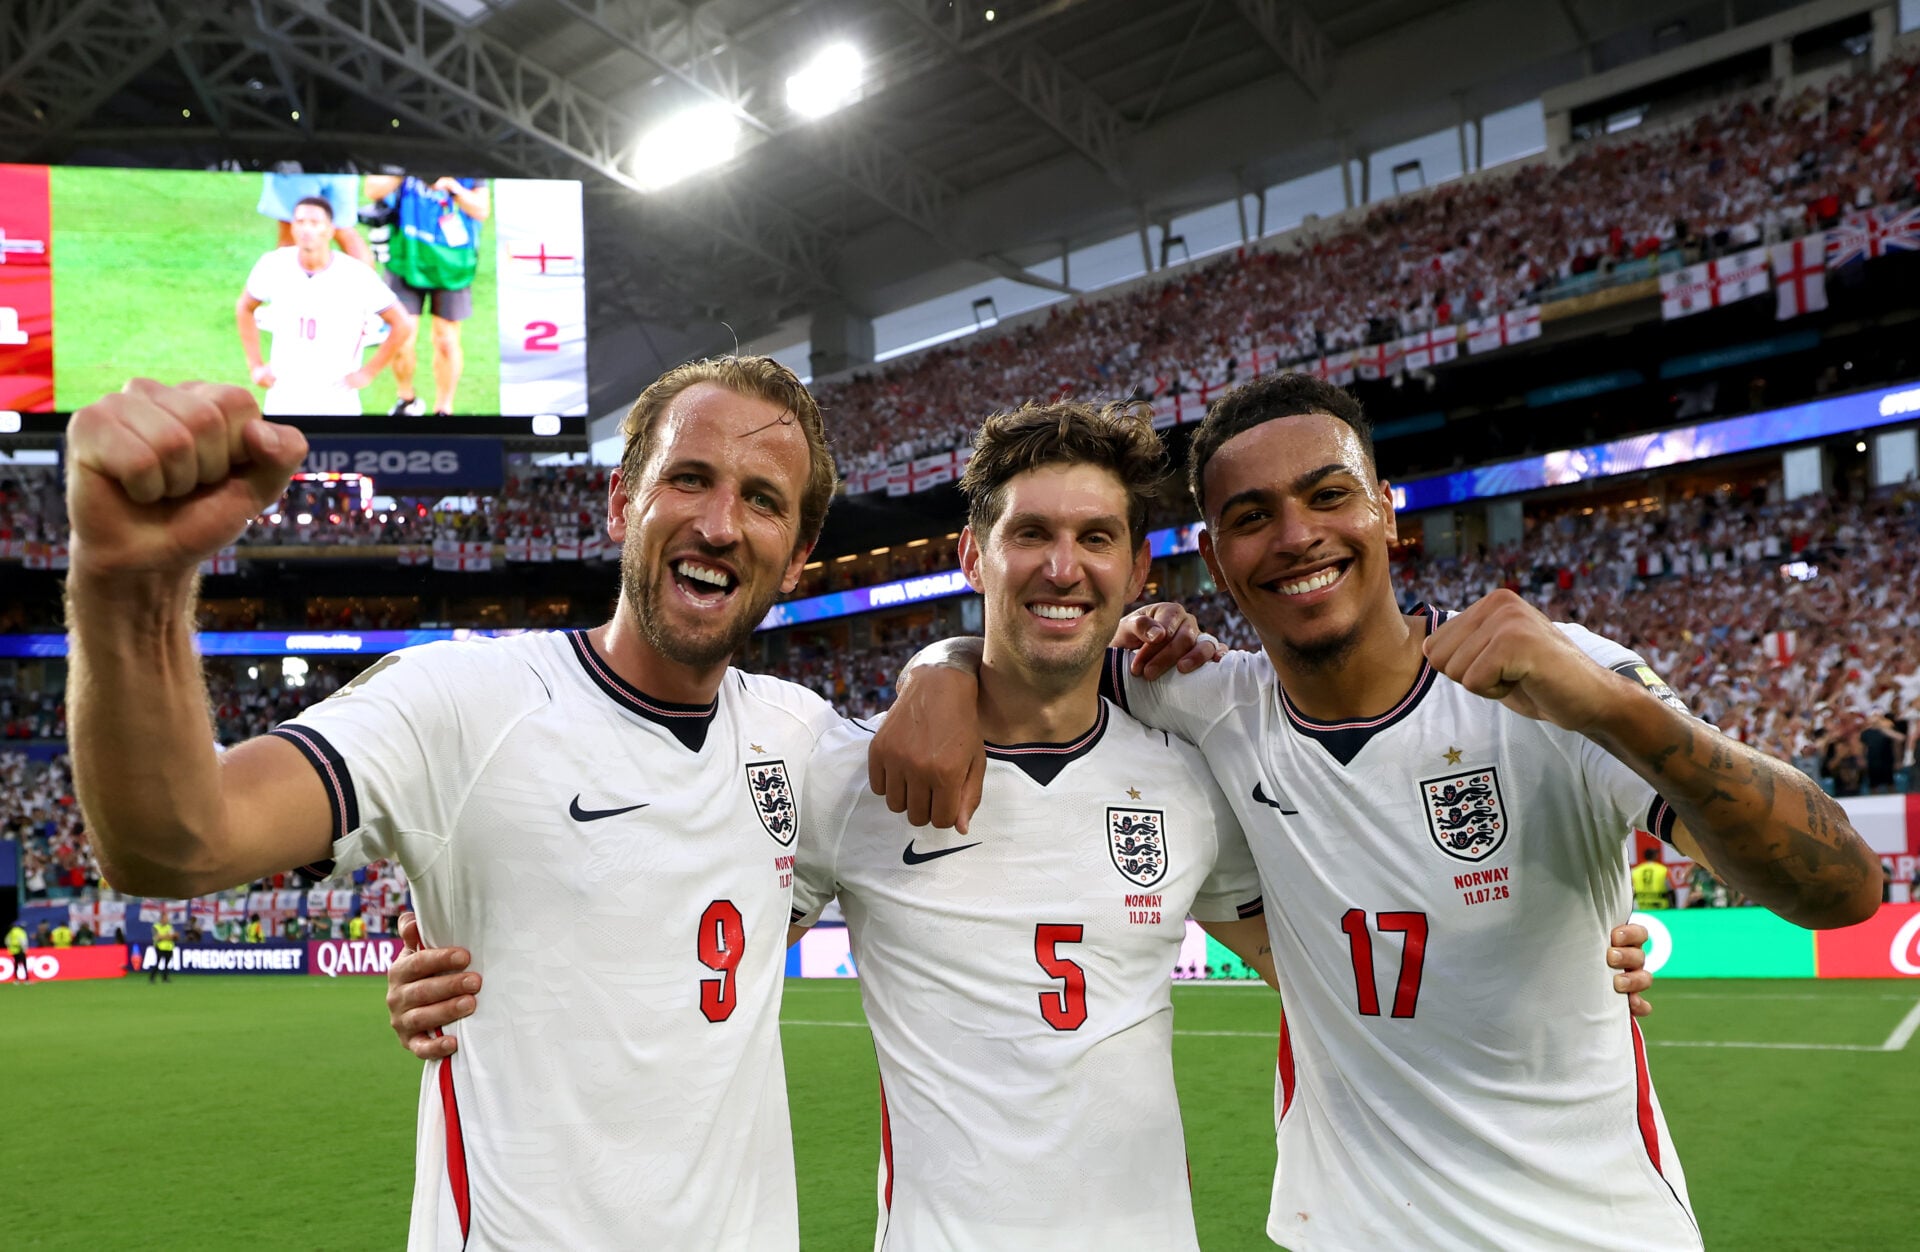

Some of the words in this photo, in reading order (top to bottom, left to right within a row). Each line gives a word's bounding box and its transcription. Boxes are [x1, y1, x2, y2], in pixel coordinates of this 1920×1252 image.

[300, 317, 316, 340] 10
[525, 321, 559, 351] 2
[354, 450, 459, 474] 2026
[775, 855, 795, 871] NORW
[1454, 866, 1509, 889] NORWAY
[1125, 894, 1162, 908] NORWAY
[1463, 885, 1510, 906] 11.07.26
[1129, 911, 1161, 925] 11.07.26
[182, 949, 303, 970] PREDICTSTREET
[317, 941, 395, 977] QATAR
[697, 900, 745, 1022] 9
[1341, 908, 1428, 1018] 17
[1034, 923, 1088, 1031] 5
